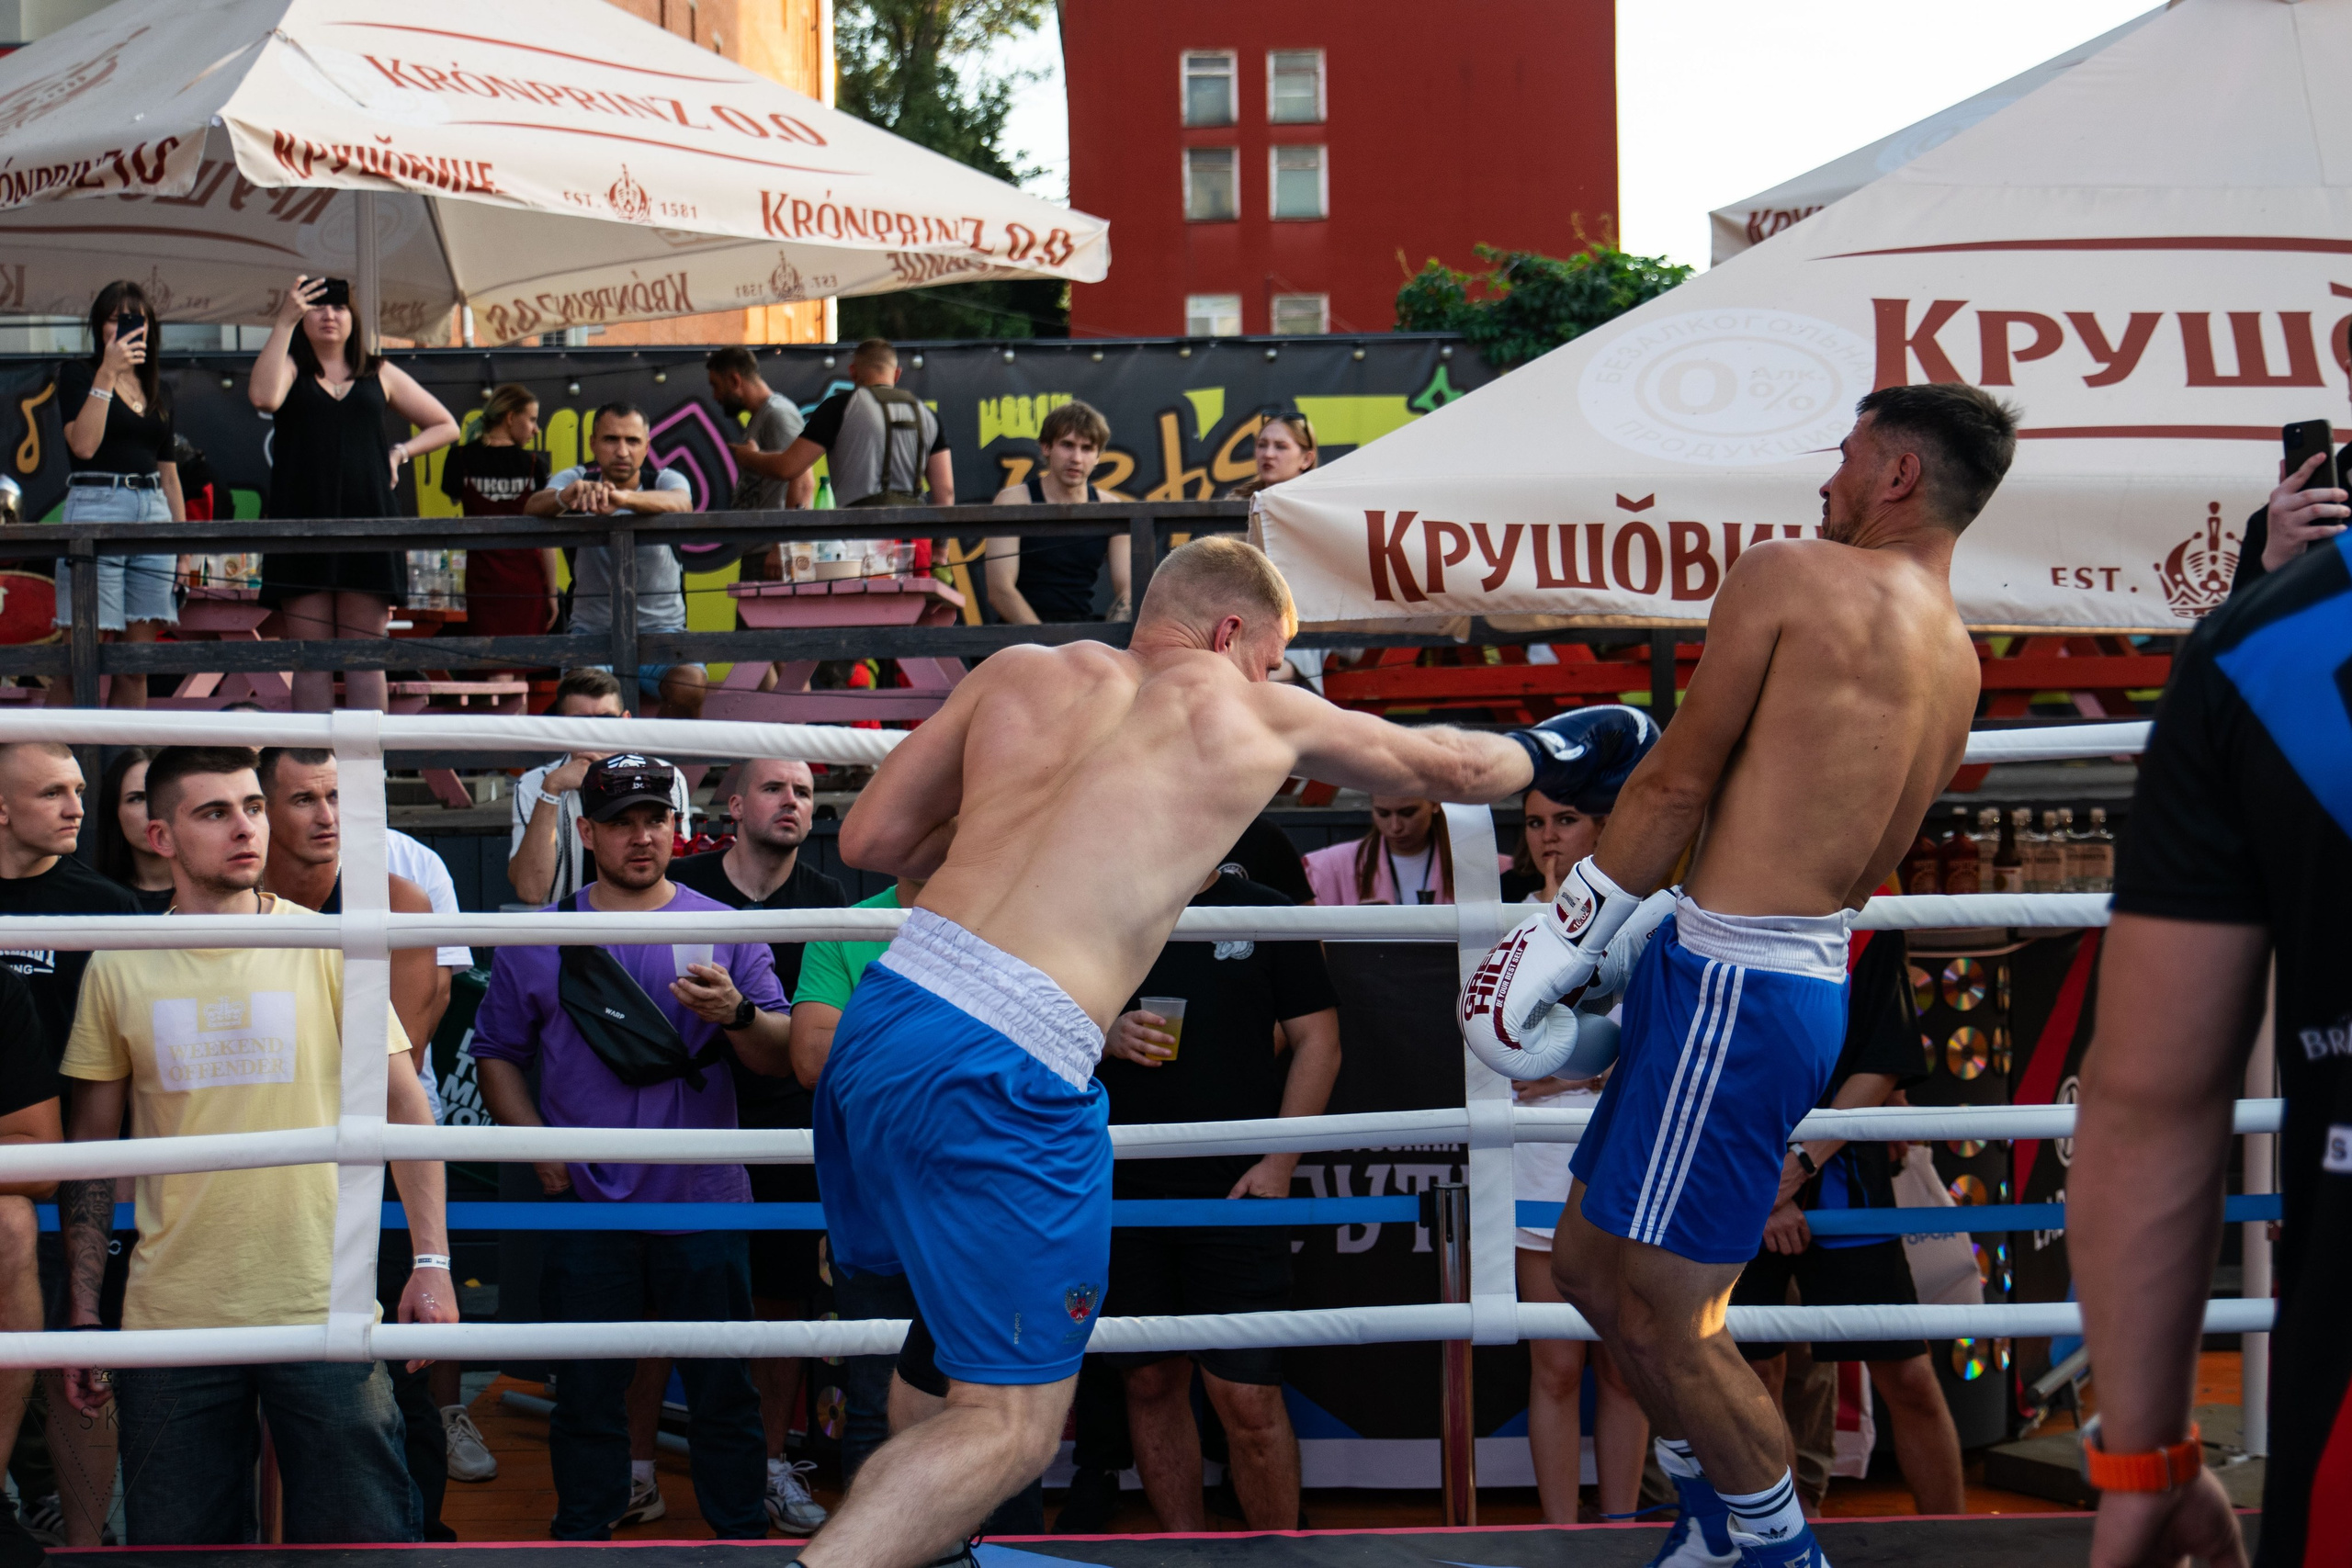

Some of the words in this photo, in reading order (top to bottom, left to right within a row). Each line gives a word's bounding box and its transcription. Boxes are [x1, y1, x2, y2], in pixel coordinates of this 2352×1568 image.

[711, 104, 828, 147] 0.0
[661, 201, 697, 220] 1581
[1613, 420, 1854, 459] ПРОДУКЦИЯ
[2051, 566, 2138, 593] EST.
[1512, 946, 1524, 963] SELF
[1474, 929, 1523, 1015] HILL
[1505, 964, 1517, 981] BEST
[1499, 980, 1510, 999] YOUR
[605, 1007, 626, 1020] WARP
[1496, 998, 1504, 1009] BE
[168, 1037, 285, 1061] WEEKEND
[2300, 1017, 2352, 1060] BR
[168, 1058, 287, 1082] OFFENDER
